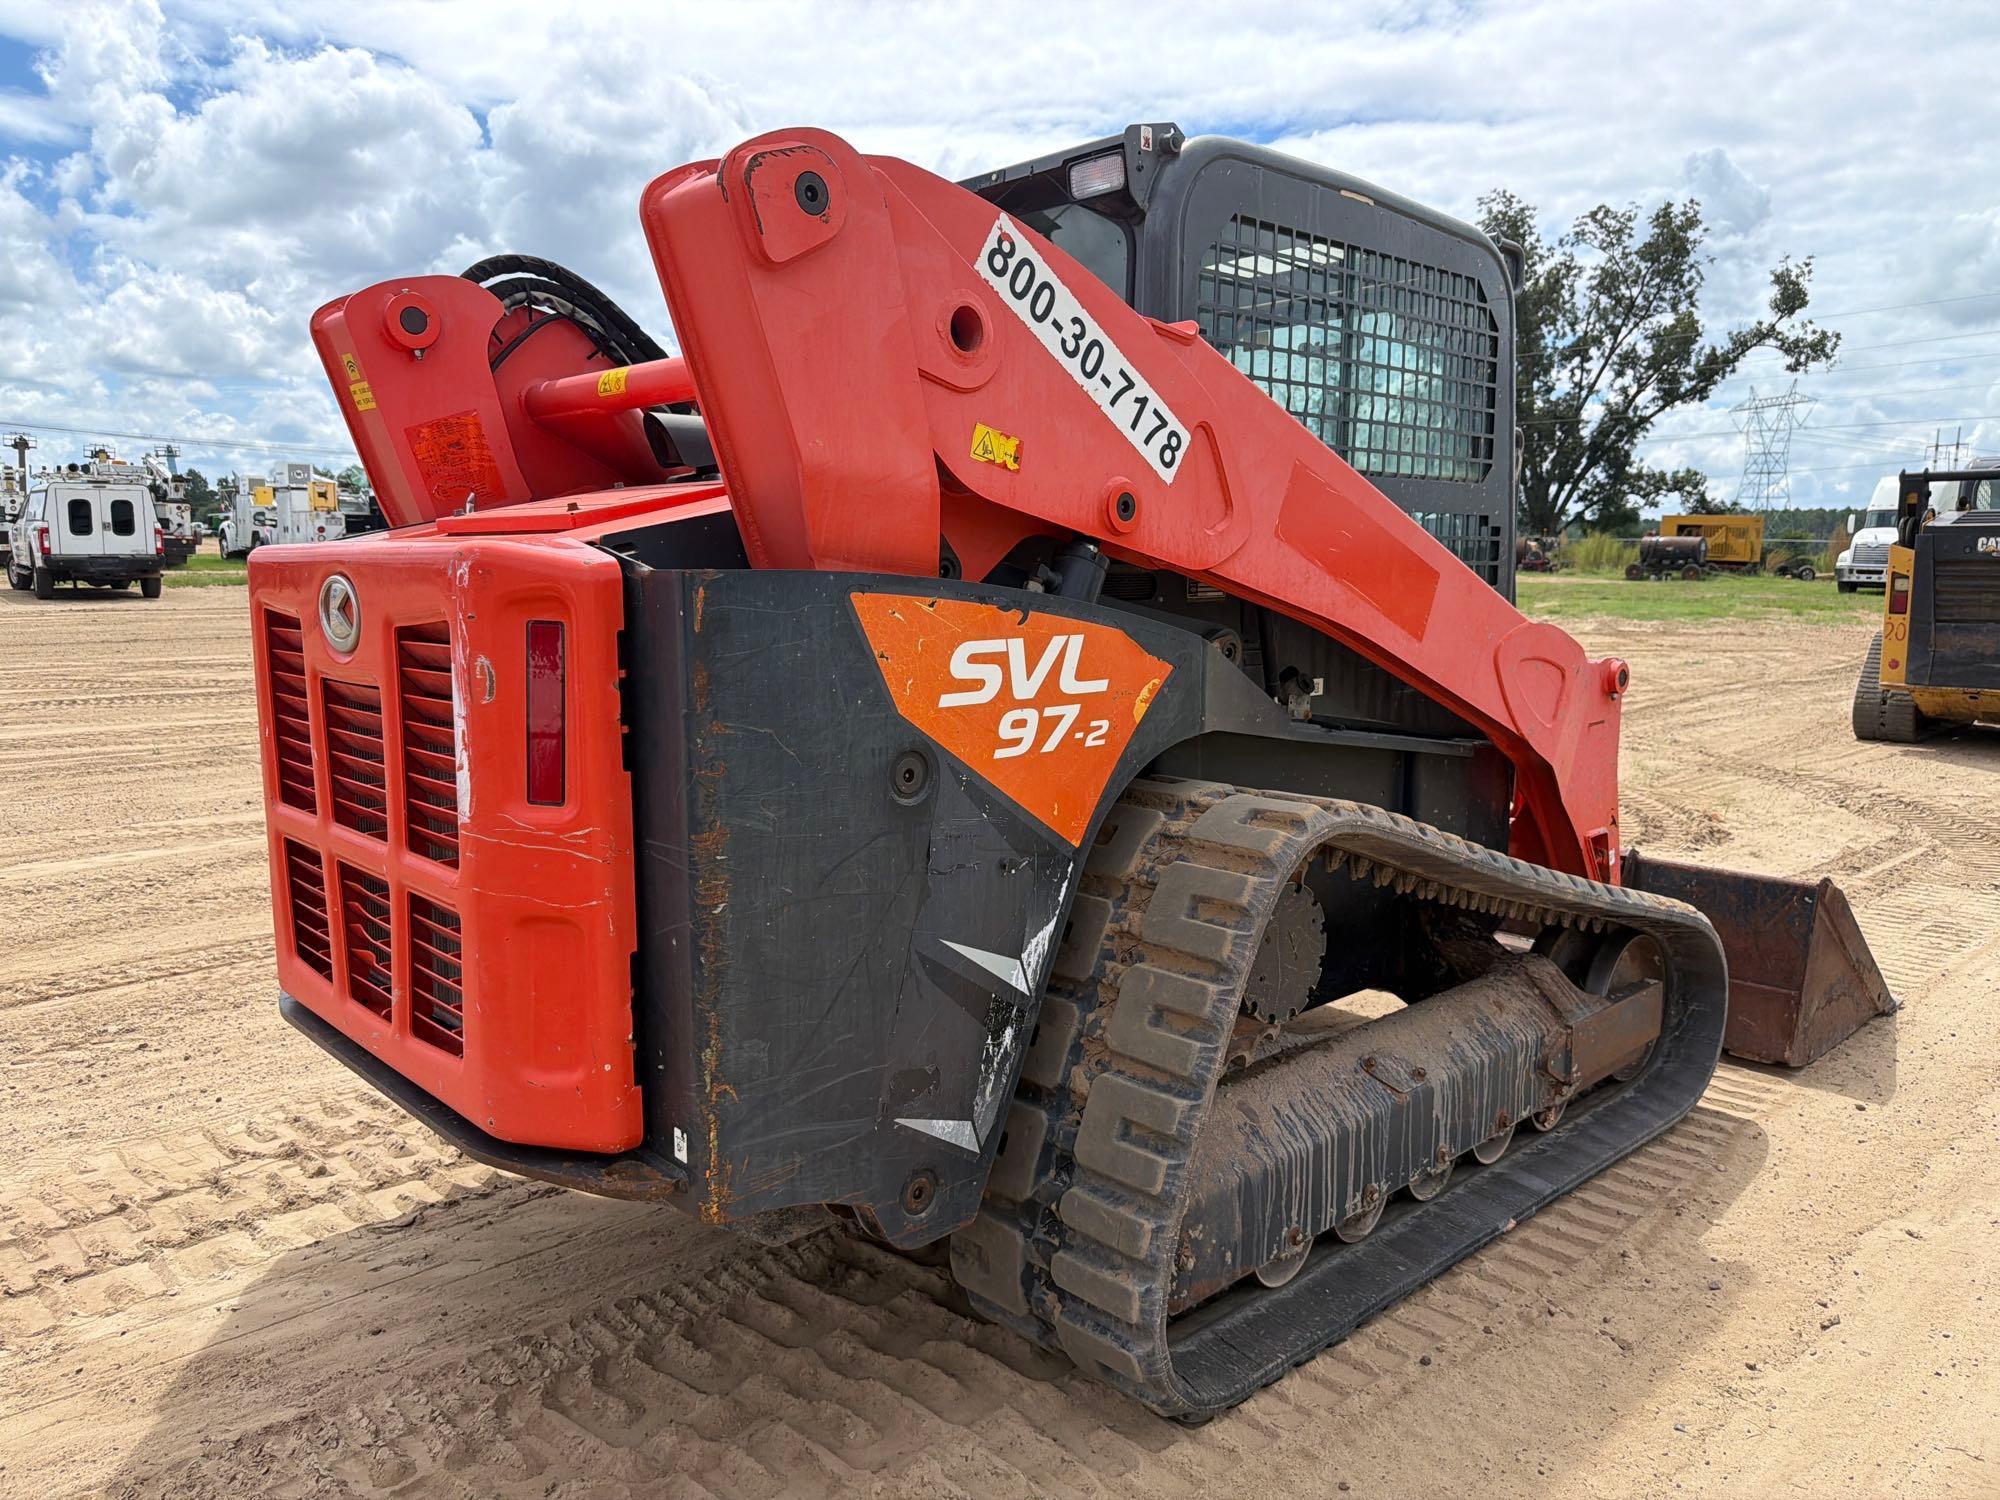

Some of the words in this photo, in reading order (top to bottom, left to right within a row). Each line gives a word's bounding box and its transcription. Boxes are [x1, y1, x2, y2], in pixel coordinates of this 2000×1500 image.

[987, 230, 1182, 469] 800-30-7178
[938, 634, 1109, 708] SVL
[993, 704, 1110, 759] 97-2
